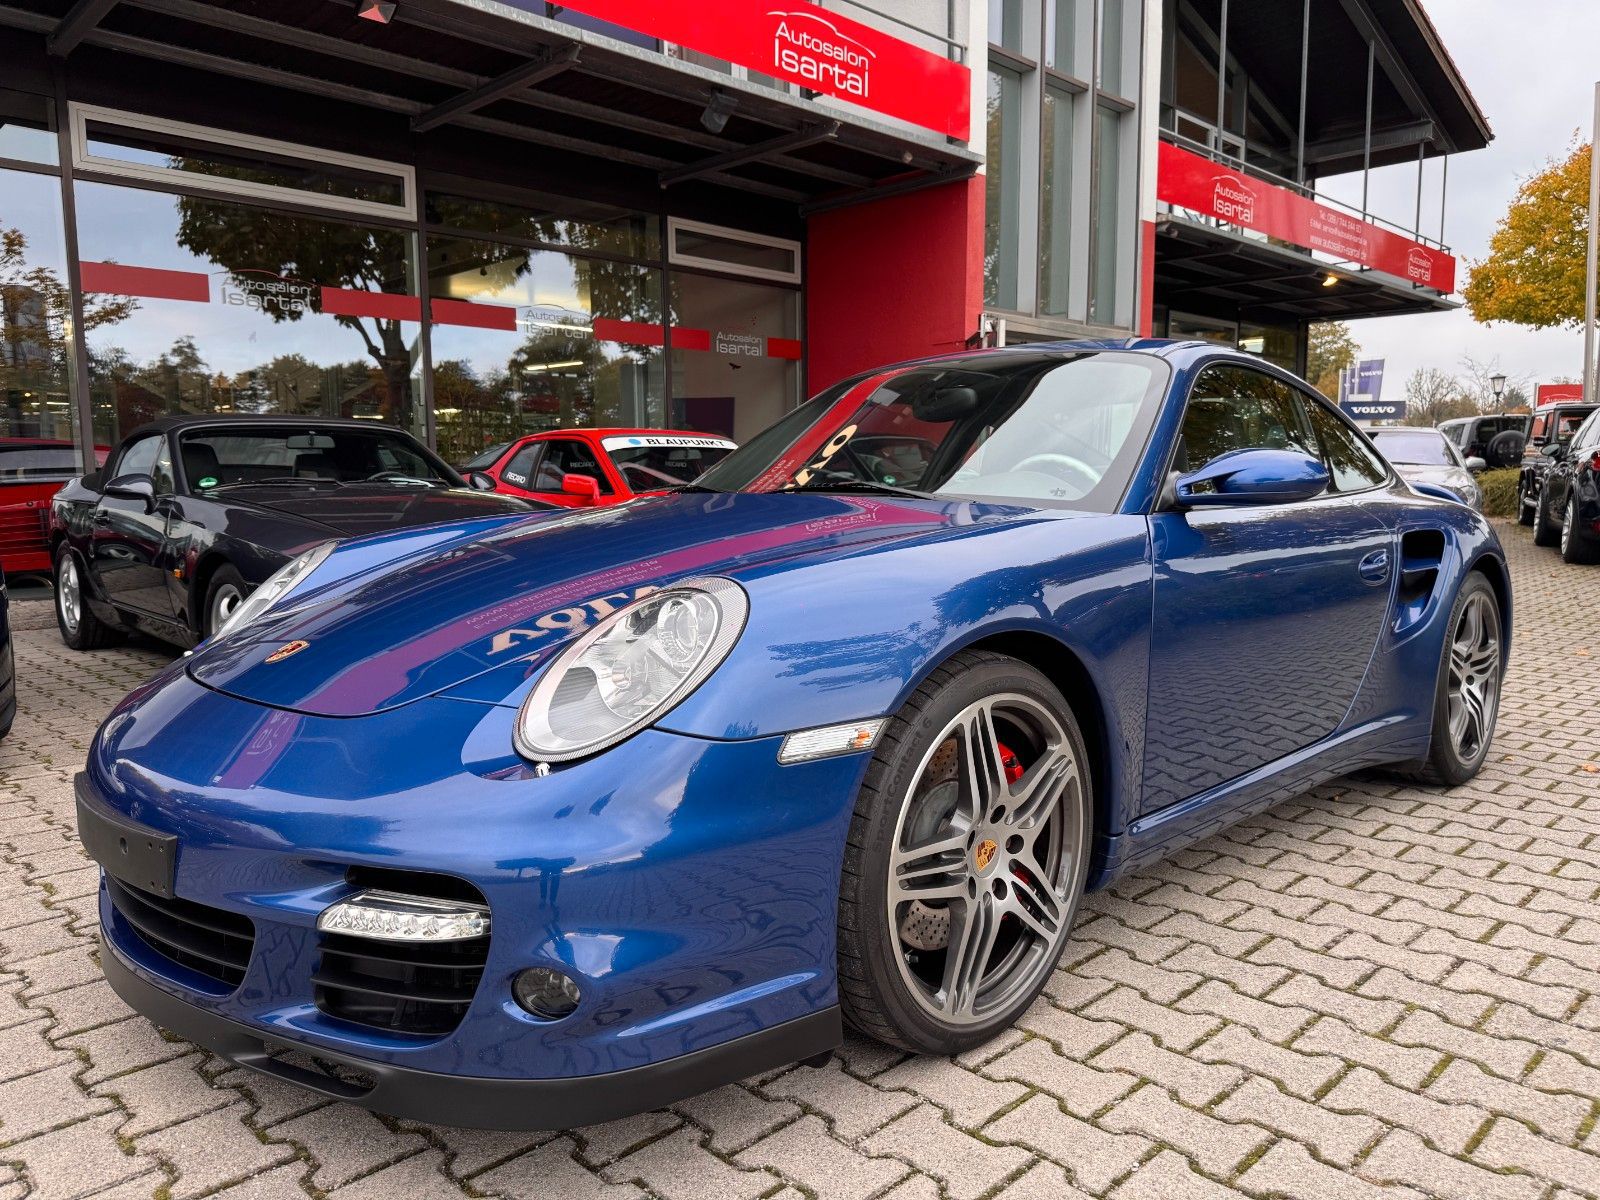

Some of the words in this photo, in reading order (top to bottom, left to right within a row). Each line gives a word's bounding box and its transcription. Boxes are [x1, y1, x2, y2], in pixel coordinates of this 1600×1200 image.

[775, 21, 869, 71] Autosalon
[774, 37, 869, 98] Isartal
[1215, 182, 1254, 206] Autosalon
[1213, 193, 1254, 224] Isartal
[1408, 261, 1431, 282] Isartal
[221, 276, 312, 295] Autosalon
[222, 287, 311, 312] Isartal
[526, 310, 587, 325] Autosalon
[525, 319, 588, 340] Isartal
[716, 331, 762, 344] Autosalon
[716, 339, 762, 357] Isartal
[1351, 406, 1396, 414] VOLVO
[645, 438, 725, 447] BLAUPUNKT
[506, 471, 526, 484] RECARO
